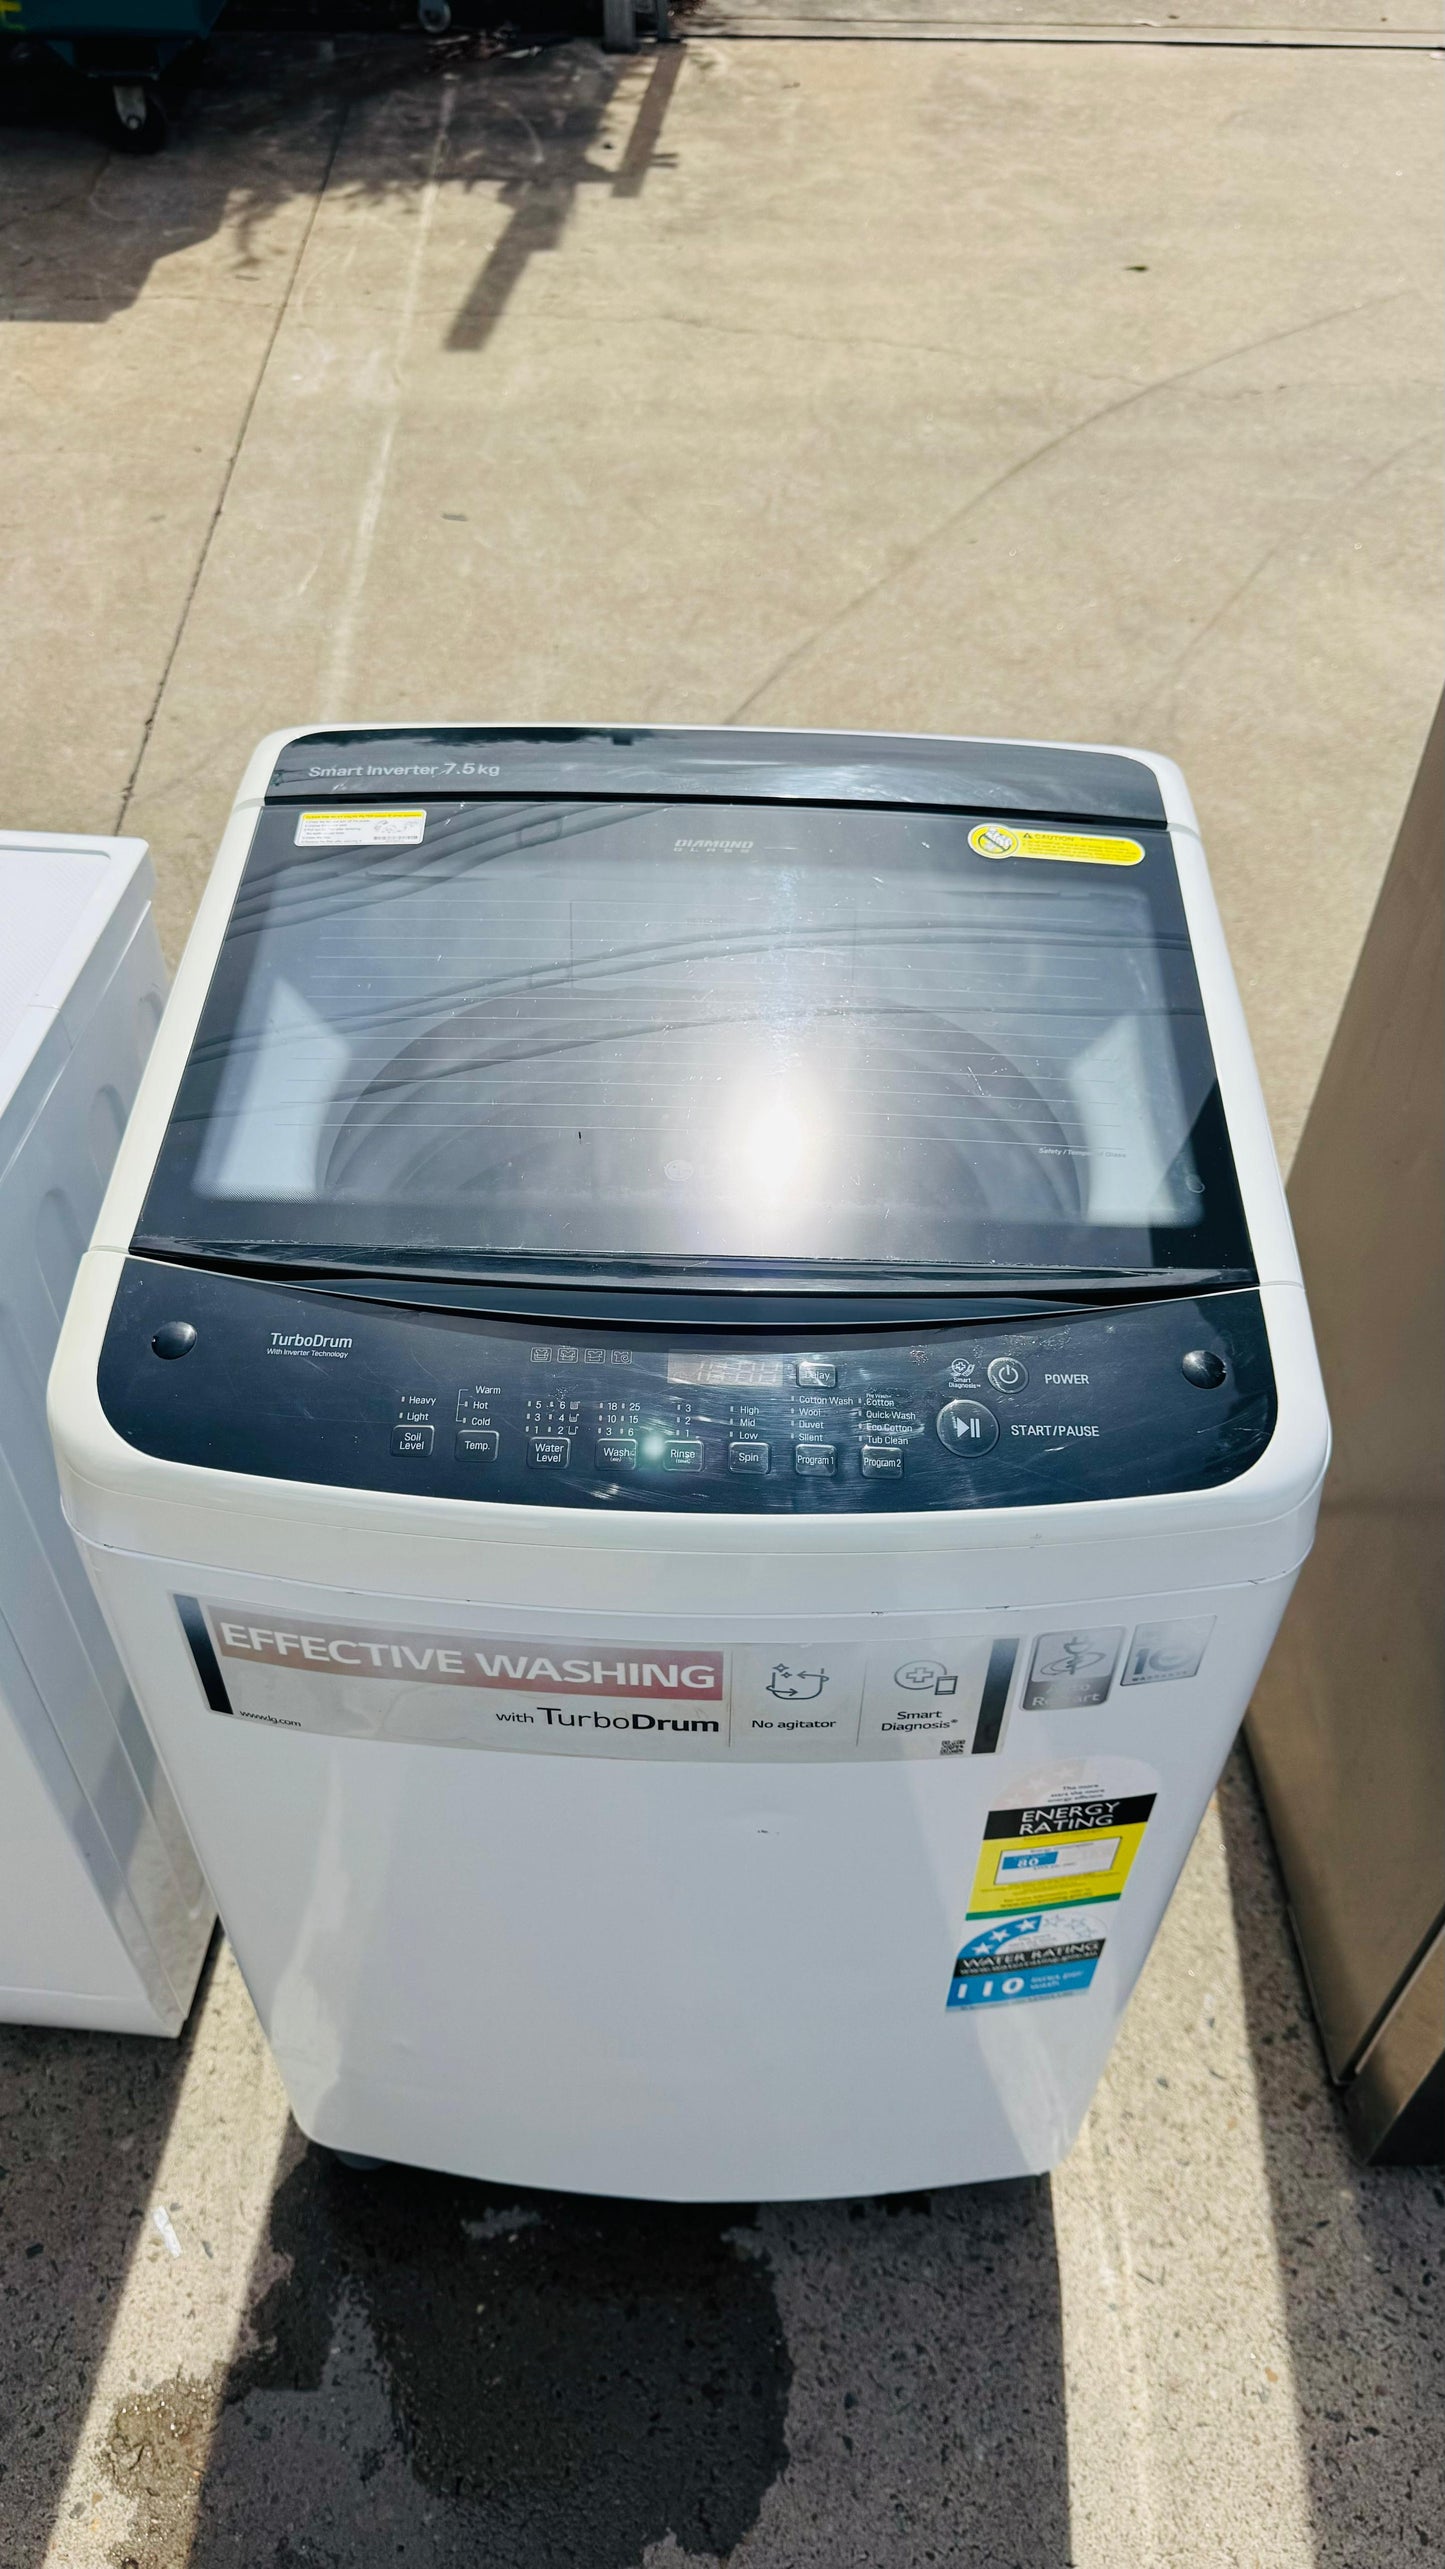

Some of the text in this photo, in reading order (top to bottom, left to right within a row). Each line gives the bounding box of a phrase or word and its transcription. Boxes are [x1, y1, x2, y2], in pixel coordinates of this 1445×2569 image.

[308, 762, 500, 777] Smart Inverter 7.5 kg
[1034, 833, 1074, 842] CAUTION
[674, 839, 754, 849] DIAMOND
[270, 1332, 353, 1348] TurboDrum
[311, 1349, 349, 1359] Technology
[1044, 1373, 1090, 1384] POWER
[475, 1385, 501, 1394] Warm
[408, 1396, 436, 1405] Heavy
[535, 1401, 566, 1409] 5 6
[799, 1396, 854, 1405] Cotton Wash
[866, 1398, 895, 1406] Cotton
[473, 1401, 489, 1410] Hot
[607, 1403, 641, 1411] 18 25
[685, 1404, 692, 1412] 3
[740, 1406, 760, 1415] High
[798, 1408, 822, 1417] Wool
[406, 1412, 429, 1421] Light
[534, 1413, 565, 1422] 3 4
[607, 1415, 639, 1424] 10 15
[866, 1411, 916, 1420] Quick Wash
[471, 1417, 491, 1426] Cold
[685, 1417, 691, 1425] 2
[740, 1419, 756, 1427] Mid
[799, 1421, 824, 1429] Duvet
[534, 1426, 563, 1435] 1 2
[606, 1428, 634, 1436] 3 6
[866, 1423, 913, 1432] Eco Cotton
[1010, 1425, 1100, 1437] START/PAUSE
[404, 1432, 422, 1441] Soil
[798, 1433, 824, 1442] Silent
[867, 1436, 909, 1445] Tub Clean
[399, 1441, 424, 1450] Level
[464, 1441, 491, 1451] Temp.
[535, 1443, 565, 1453] Water
[603, 1448, 630, 1457] Wash
[670, 1450, 696, 1459] Rinse
[536, 1453, 561, 1462] Level
[738, 1453, 759, 1463] Spin
[797, 1455, 835, 1466] Program 1
[864, 1457, 902, 1469] Program 2
[219, 1622, 715, 1689] EFFECTIVE WASHING
[240, 1711, 302, 1727] www.lg.com
[496, 1707, 719, 1732] with TurboDrum
[897, 1710, 943, 1720] Smart
[752, 1719, 837, 1731] No agitator
[1022, 1801, 1120, 1823] ENERGY
[1019, 1815, 1115, 1836] RATING
[963, 1943, 1099, 1968] WATER RATING
